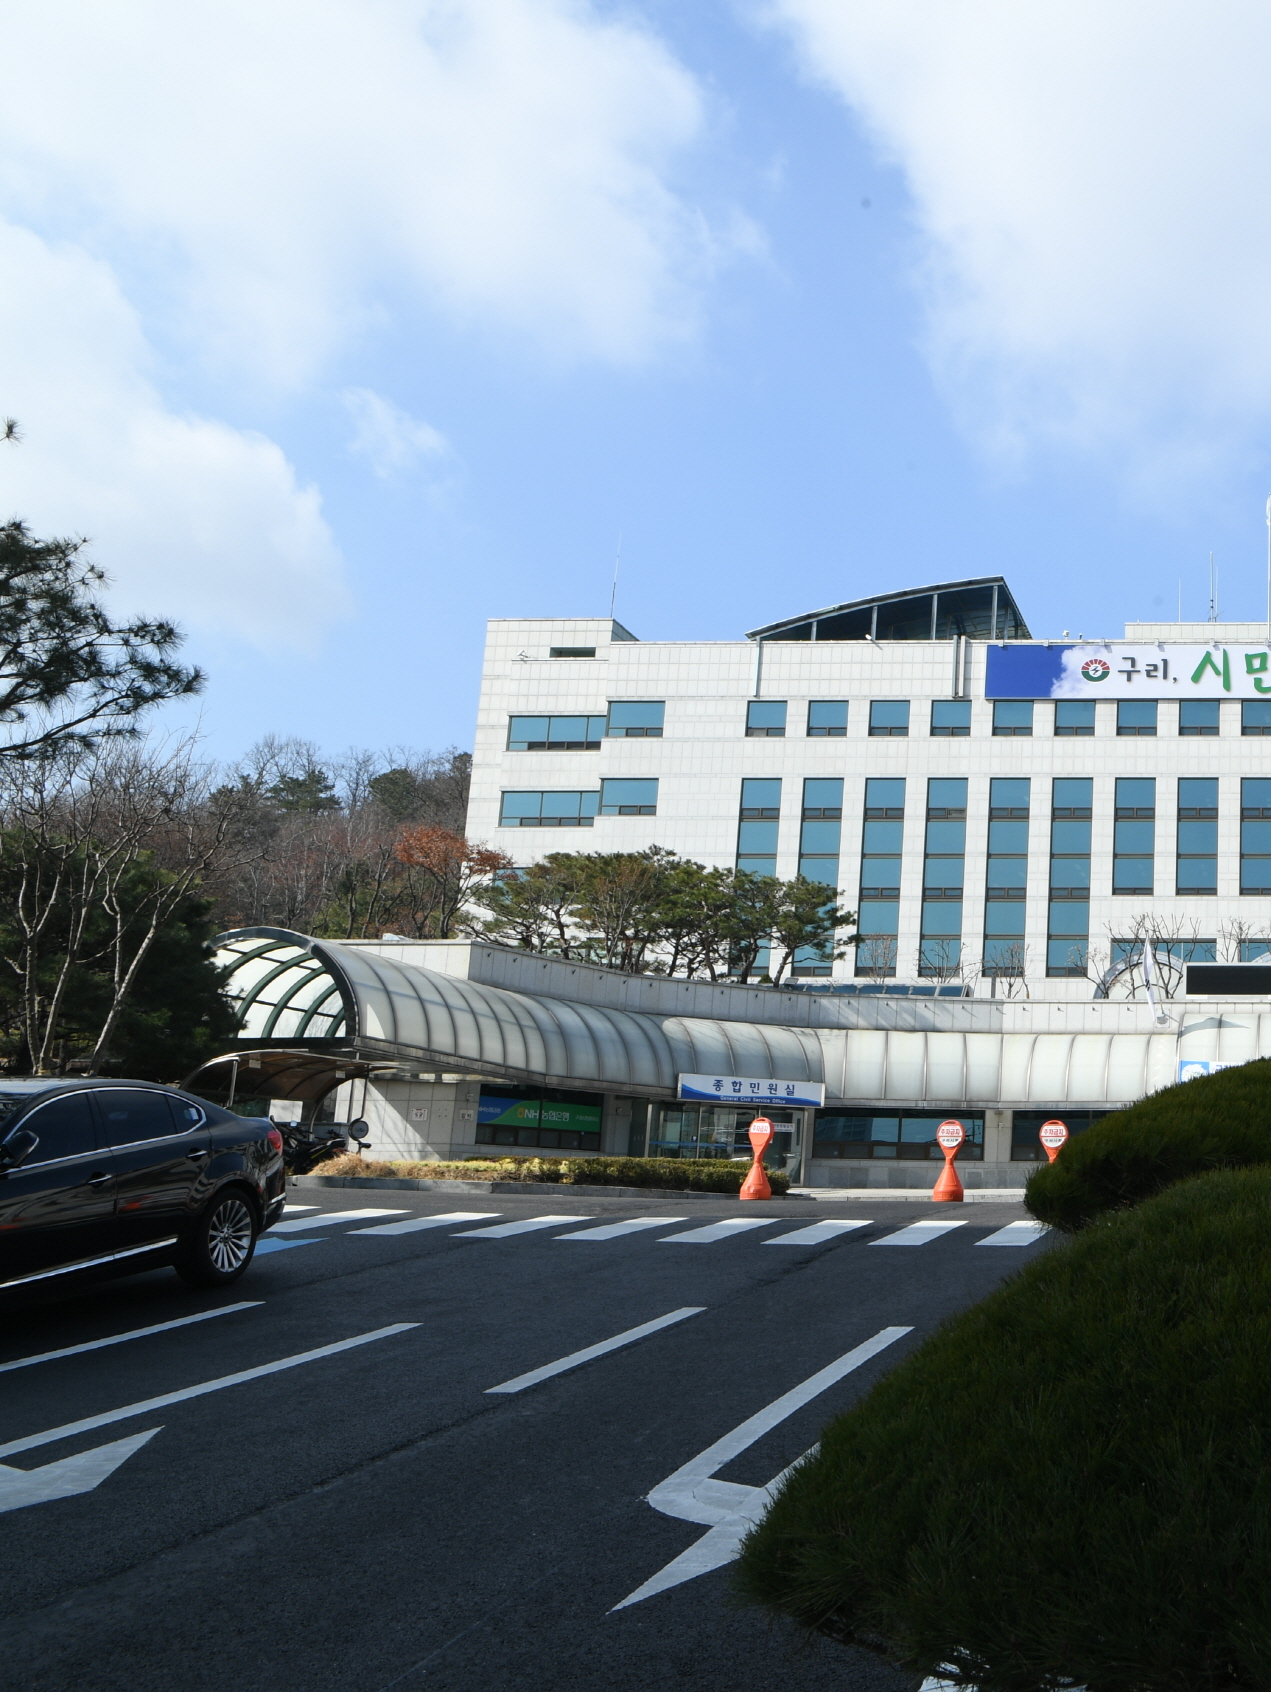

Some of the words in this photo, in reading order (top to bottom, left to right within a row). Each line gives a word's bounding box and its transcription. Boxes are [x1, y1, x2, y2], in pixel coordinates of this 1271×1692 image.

[1117, 656, 1178, 683] 구리,
[712, 1079, 795, 1096] 종합민원실
[524, 1109, 570, 1122] NH농협은행
[1043, 1128, 1064, 1136] 주차금지
